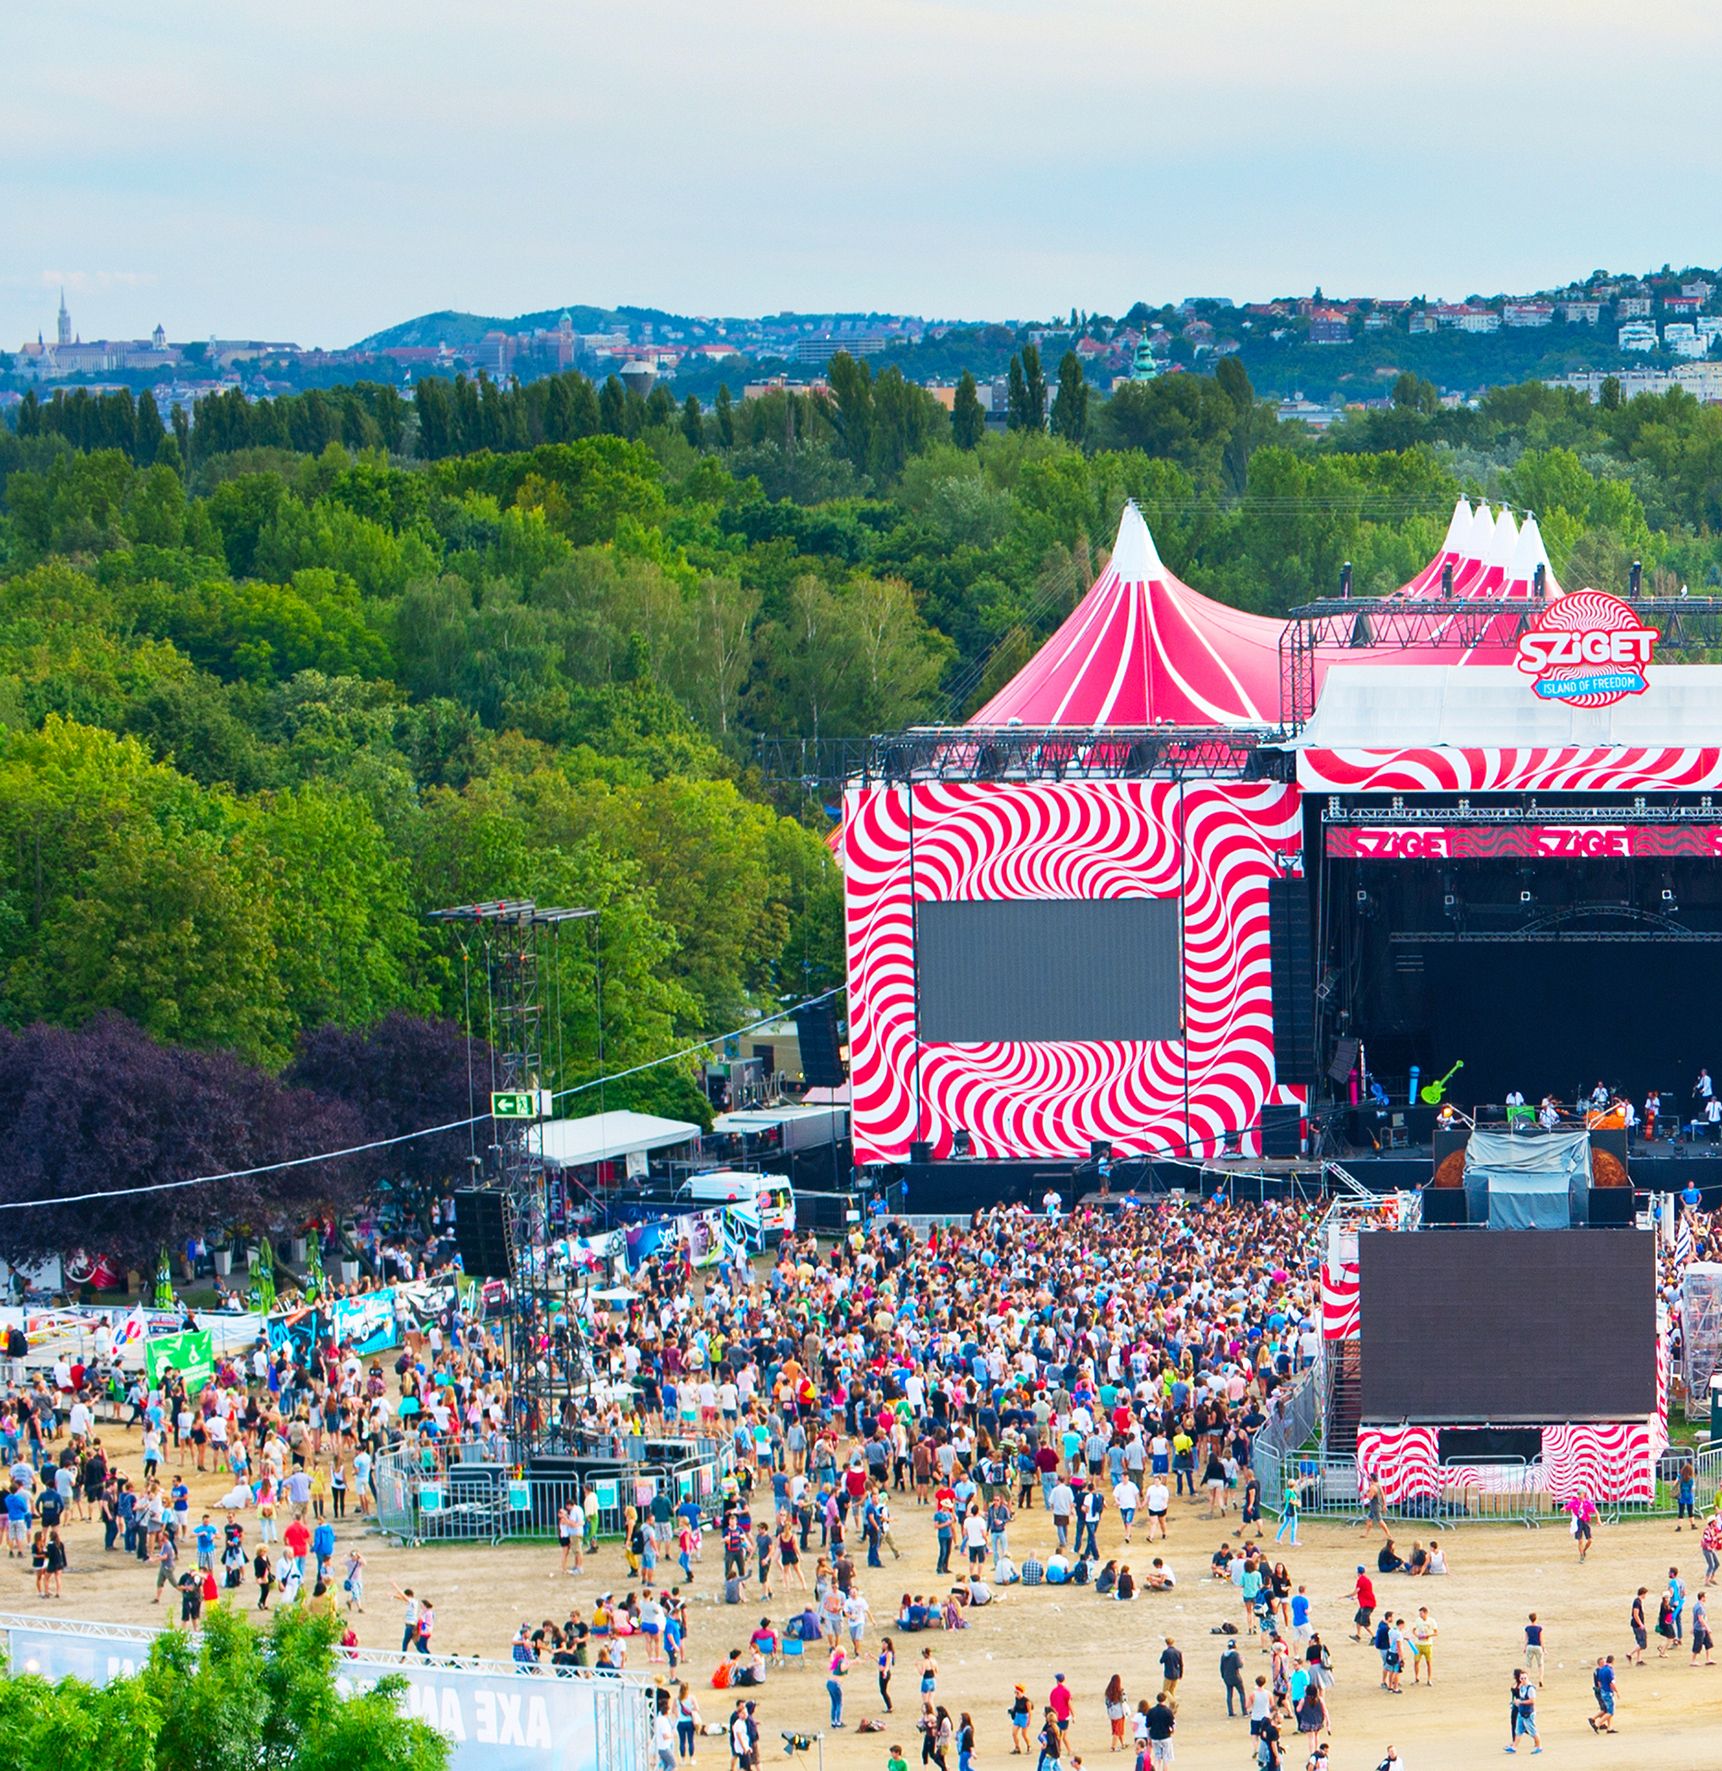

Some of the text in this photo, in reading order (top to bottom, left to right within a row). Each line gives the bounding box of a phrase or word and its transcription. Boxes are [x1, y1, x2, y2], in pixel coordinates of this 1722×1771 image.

[1543, 676, 1635, 695] ISLAND OF FREEDOM
